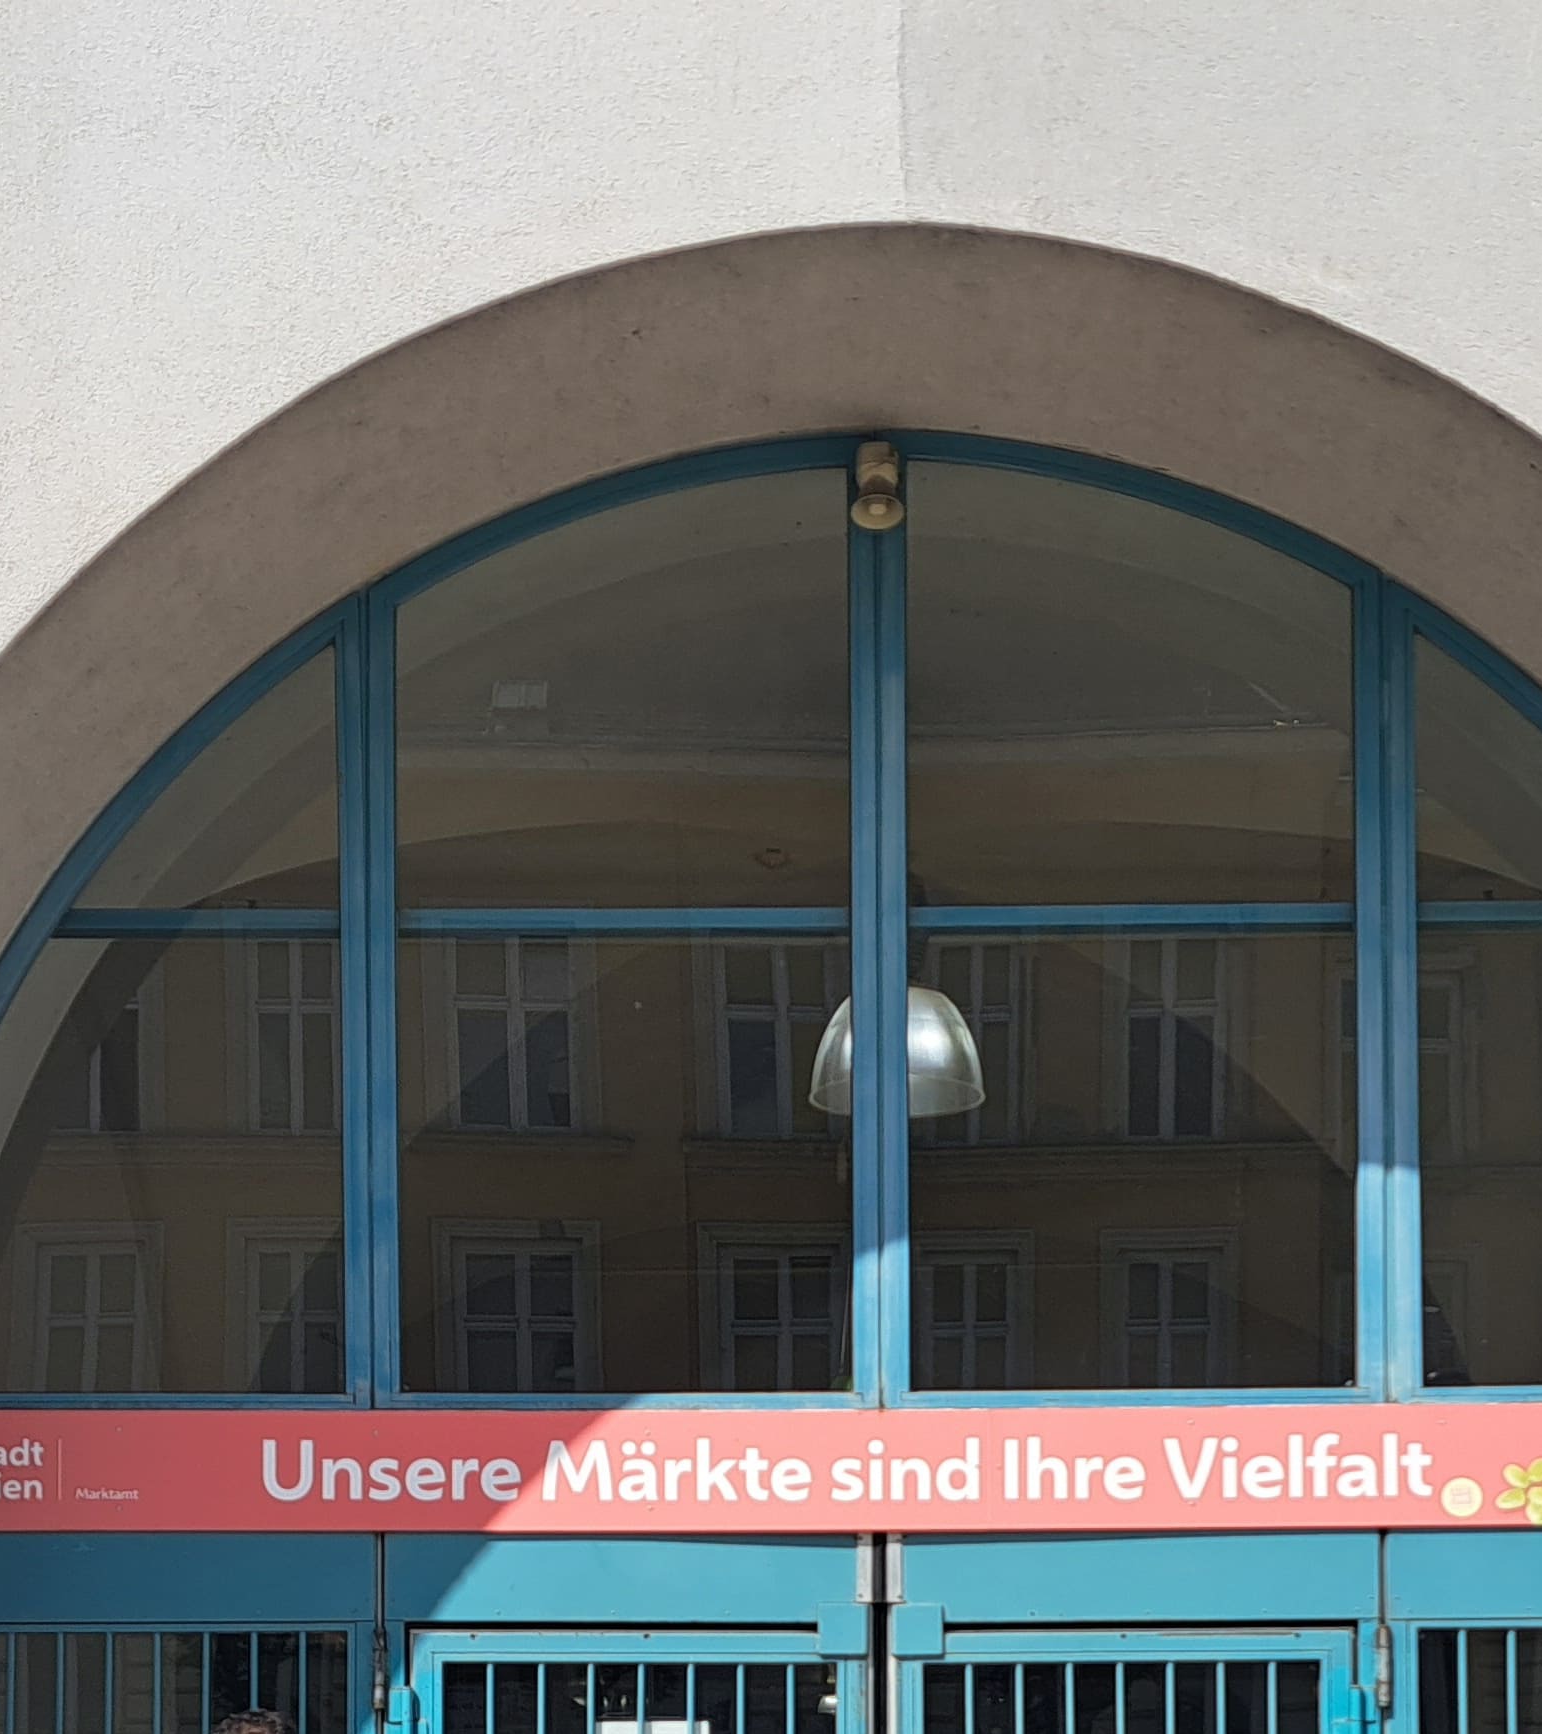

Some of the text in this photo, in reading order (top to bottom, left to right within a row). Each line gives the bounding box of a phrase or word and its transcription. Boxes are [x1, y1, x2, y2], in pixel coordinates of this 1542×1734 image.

[262, 1432, 1434, 1502] Unsere Märkte sind Ihre Vielfalt
[75, 1486, 139, 1501] Marktamt
